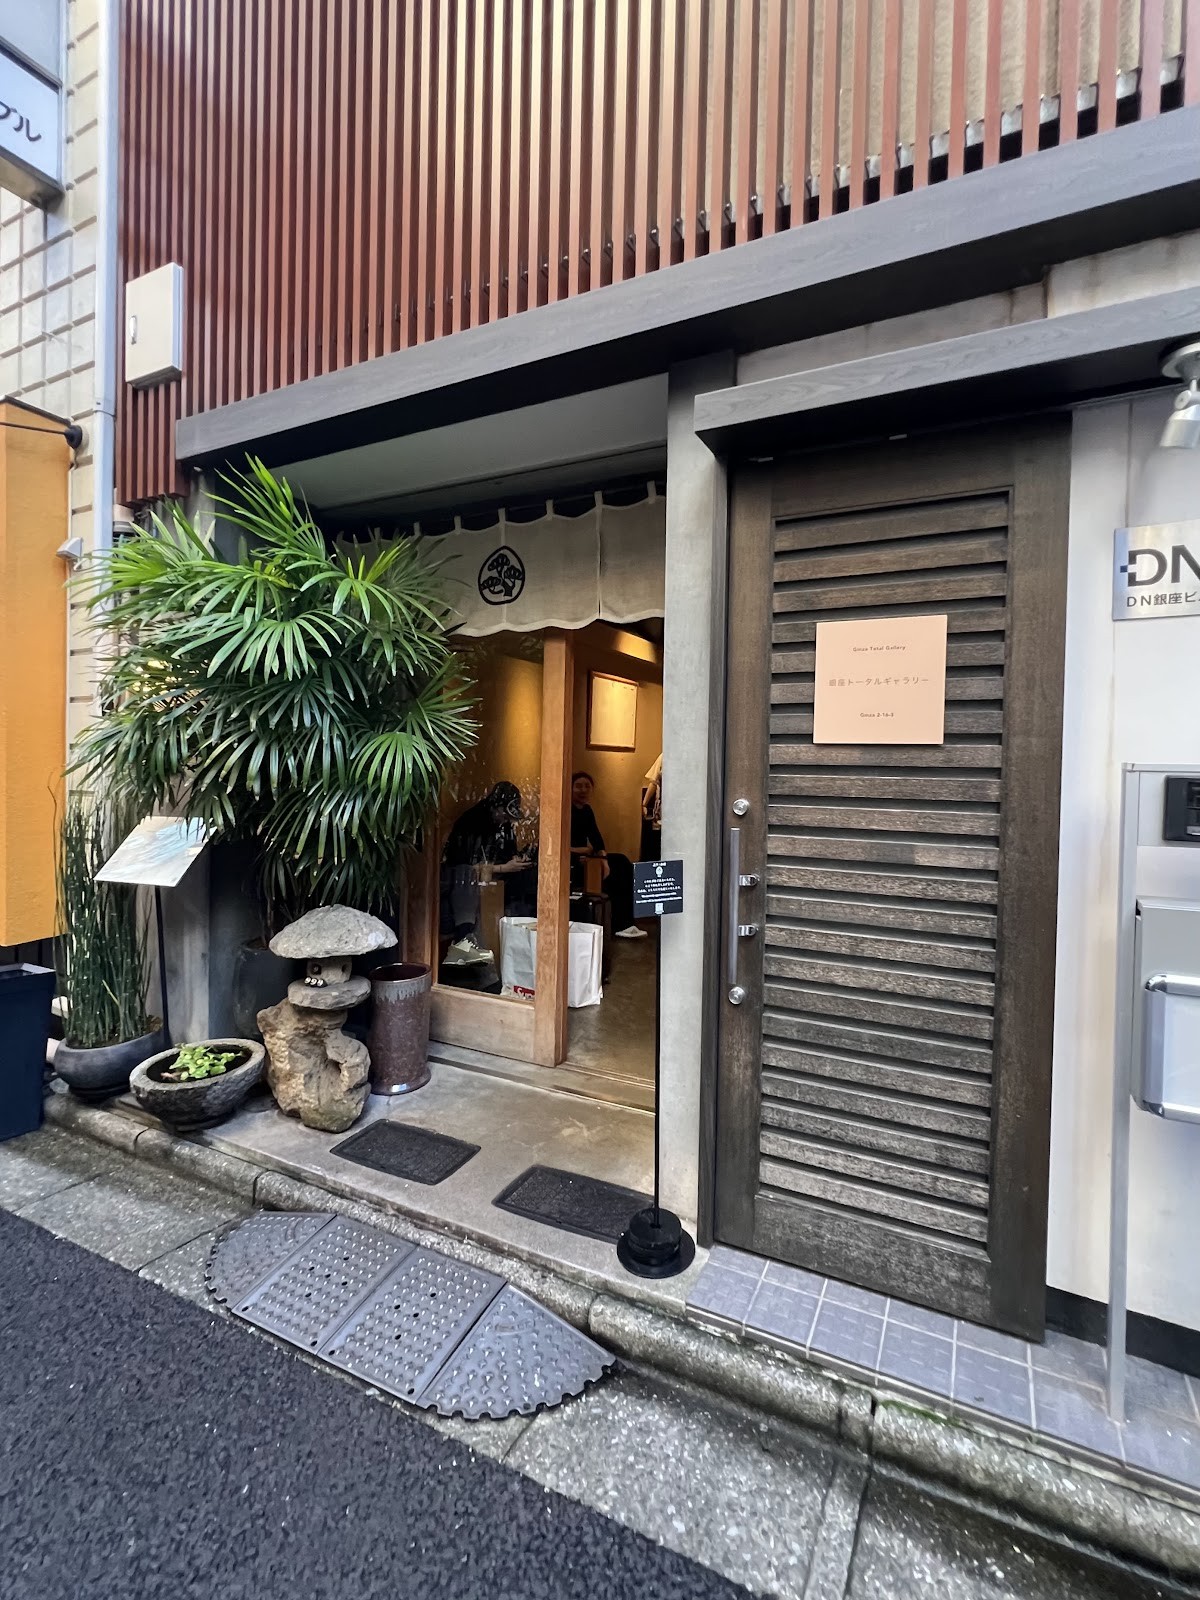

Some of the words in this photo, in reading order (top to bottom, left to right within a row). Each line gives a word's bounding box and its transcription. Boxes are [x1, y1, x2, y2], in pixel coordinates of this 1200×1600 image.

[829, 677, 928, 686] 銀座トータルギャラリー
